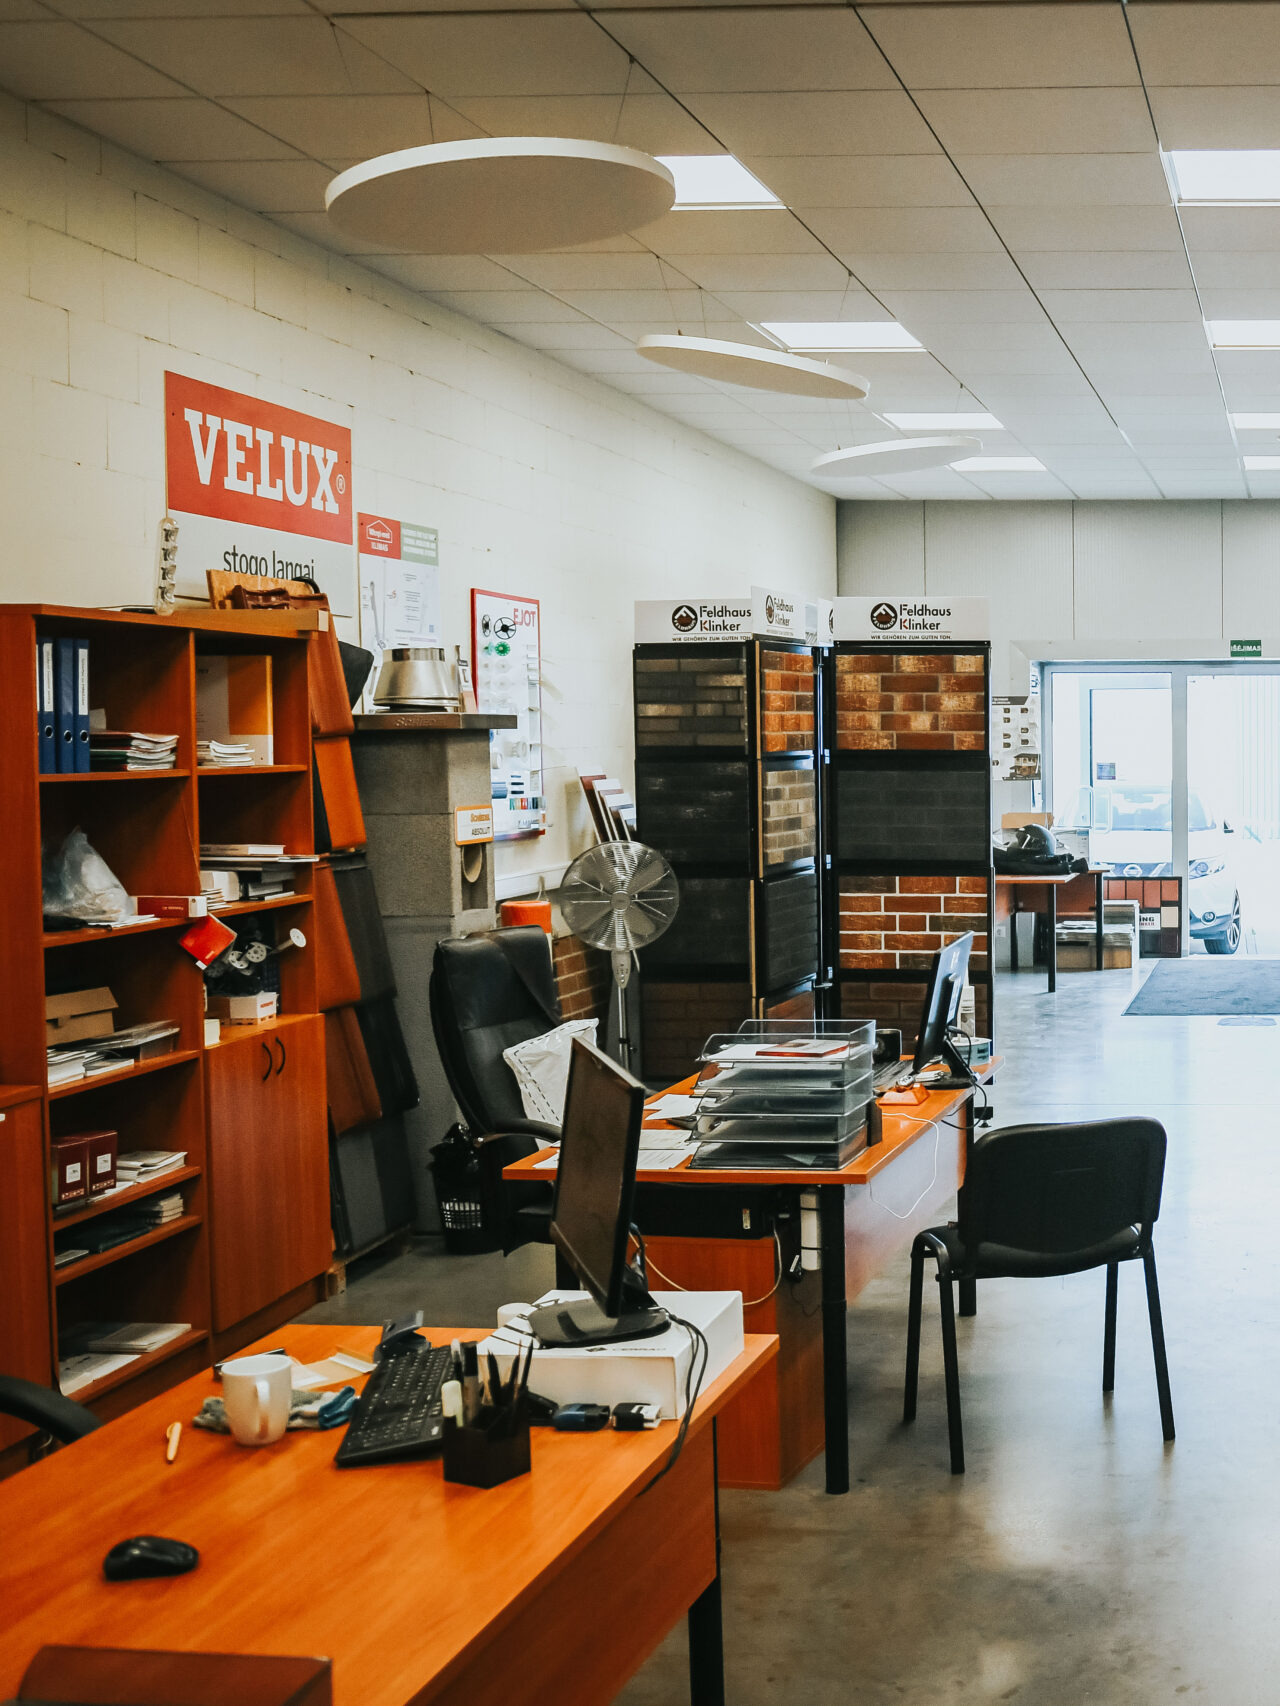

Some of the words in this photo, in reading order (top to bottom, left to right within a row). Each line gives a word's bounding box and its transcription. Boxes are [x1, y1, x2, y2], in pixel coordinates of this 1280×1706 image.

[700, 605, 752, 618] Feldhaus
[900, 604, 952, 616] Feldhaus
[700, 619, 741, 632] Klinker
[900, 618, 941, 631] Klinker
